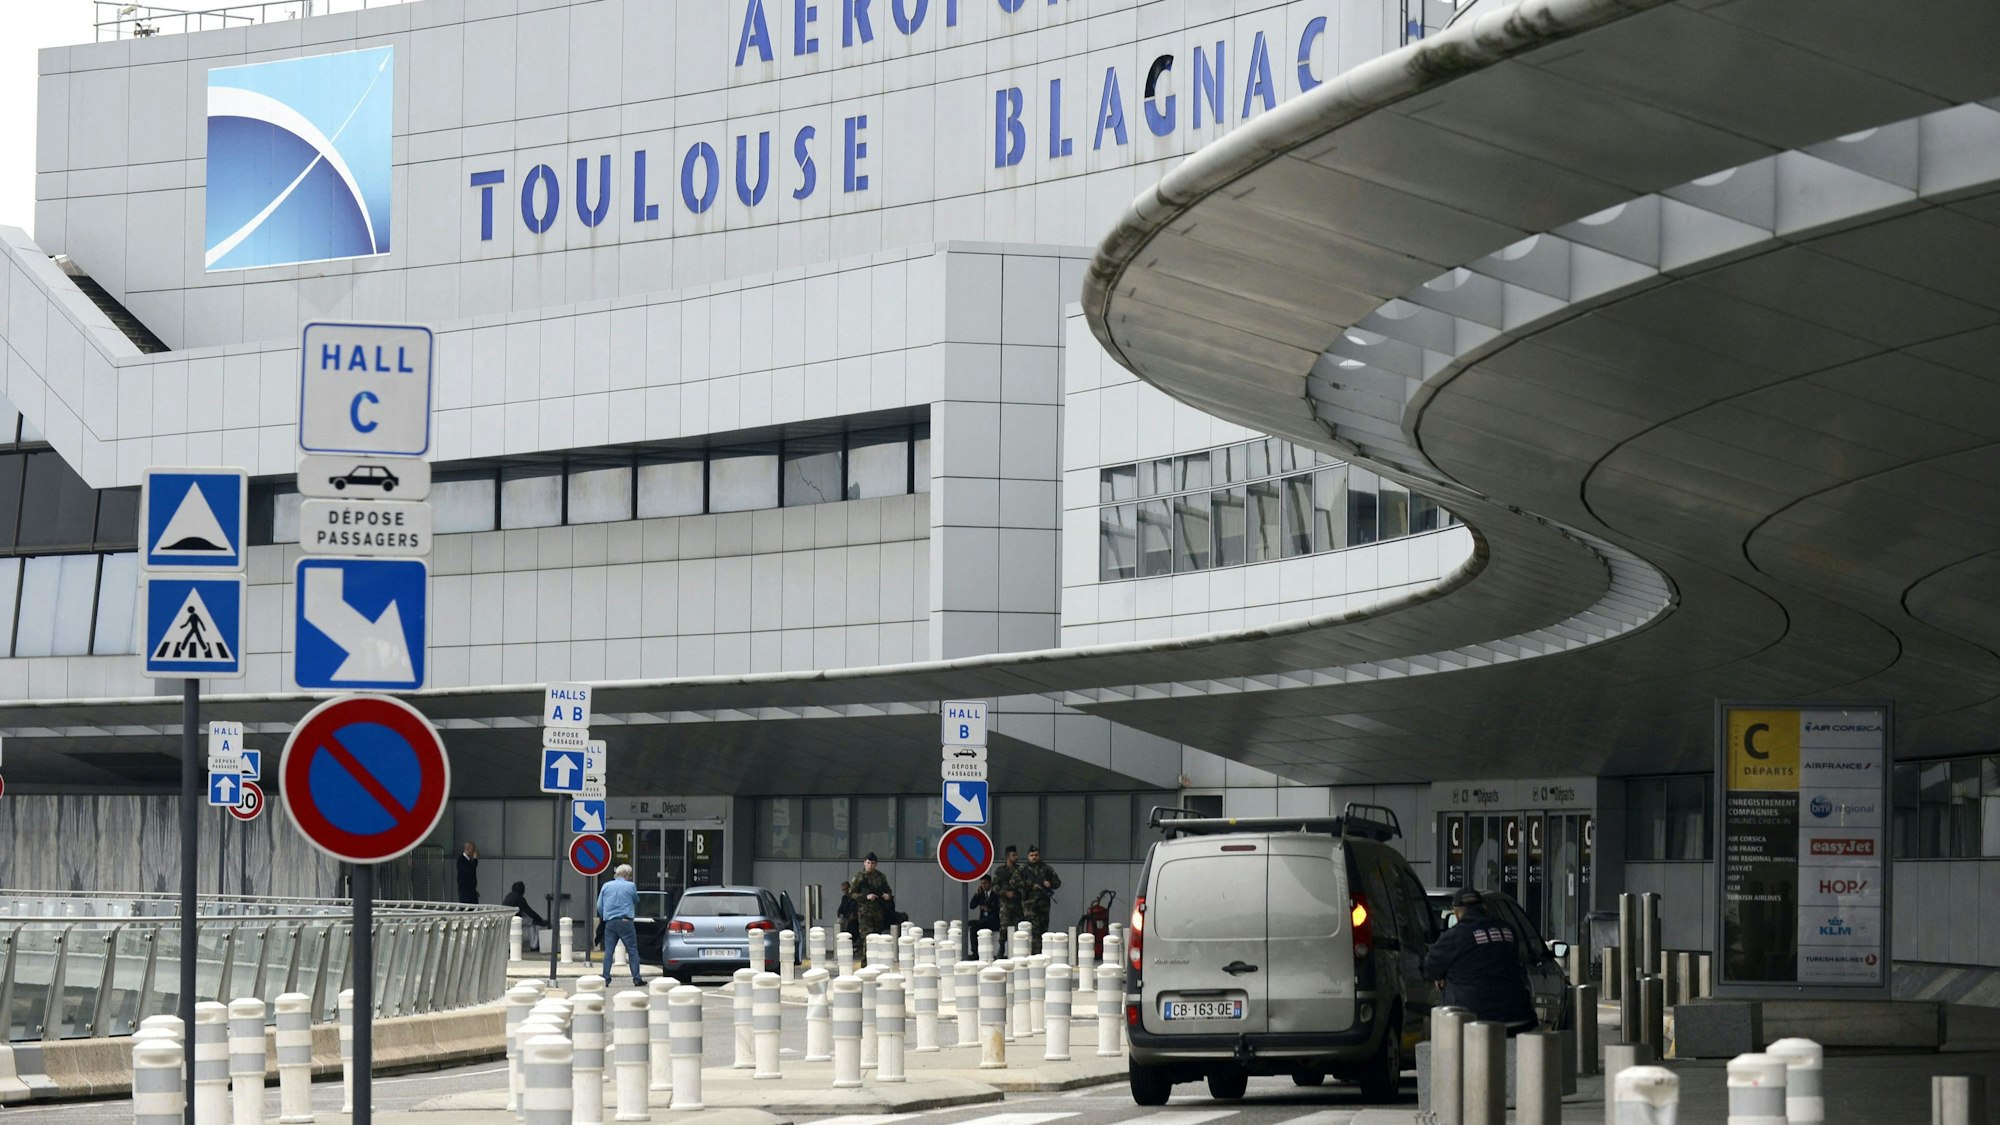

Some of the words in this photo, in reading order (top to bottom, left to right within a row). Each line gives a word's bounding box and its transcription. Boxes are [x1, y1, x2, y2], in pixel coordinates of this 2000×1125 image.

[470, 114, 869, 241] TOULOUSE
[994, 15, 1328, 169] BLAGNAC
[321, 343, 414, 374] HALL
[349, 390, 380, 434] C
[328, 507, 405, 527] DÉPOSE
[317, 530, 419, 548] PASSAGERS
[551, 689, 586, 701] HALLS
[949, 708, 980, 719] HALL
[213, 727, 239, 736] HALL
[553, 730, 579, 738] DÉPOSE
[959, 724, 970, 739] B
[221, 739, 230, 752] A
[549, 738, 584, 746] PASSAGERS
[1743, 722, 1770, 760] C
[1744, 765, 1794, 776] DÉPARTS
[662, 801, 687, 816] Départs
[1728, 808, 1779, 816] COMPAGNIES
[1452, 821, 1459, 847] C
[1507, 821, 1514, 847] C
[1532, 821, 1538, 847] C
[616, 833, 624, 853] B
[696, 834, 704, 854] B
[1812, 840, 1872, 854] easyJet
[1819, 926, 1852, 936] KLM
